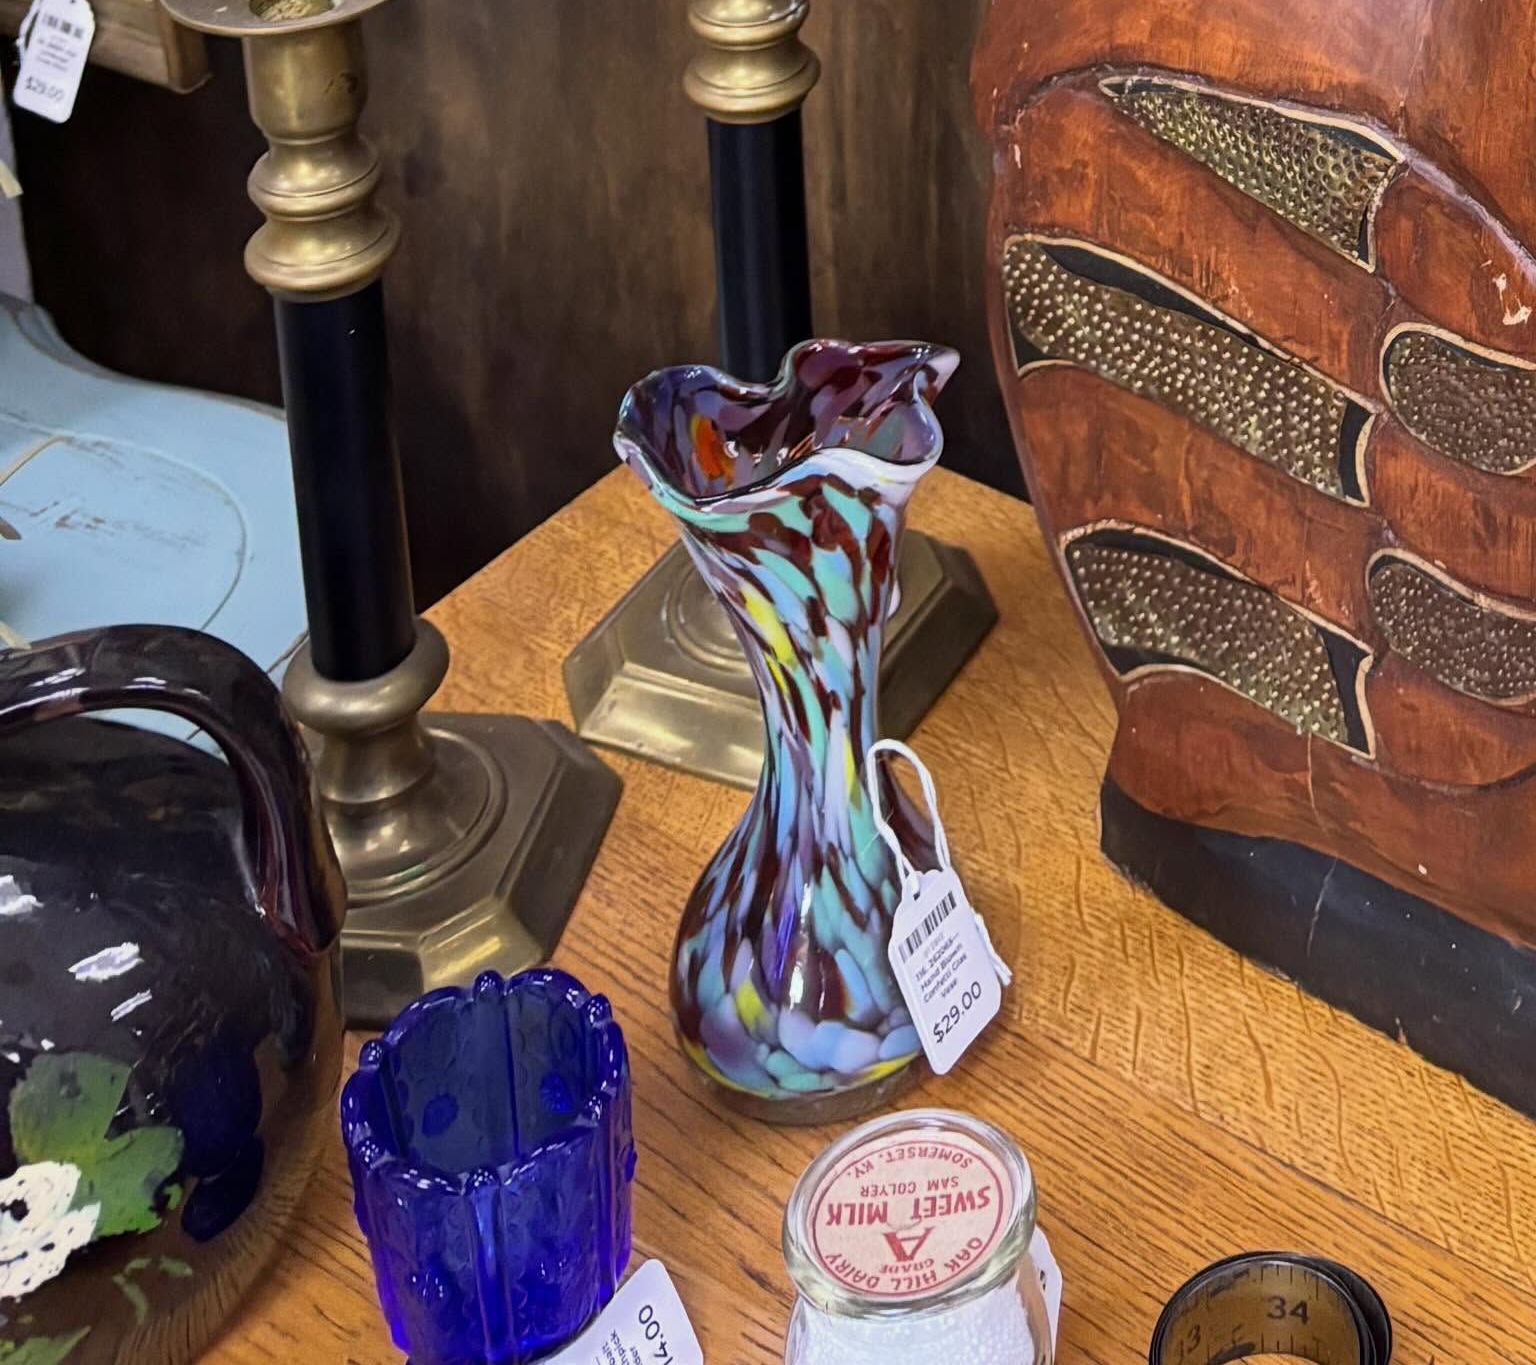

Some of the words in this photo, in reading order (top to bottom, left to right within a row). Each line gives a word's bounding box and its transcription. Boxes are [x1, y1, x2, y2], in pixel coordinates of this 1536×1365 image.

[933, 981, 982, 1044] $29.00
[859, 1182, 917, 1198] COLYER
[926, 1175, 960, 1191] SAM
[826, 1201, 889, 1227] MILK
[910, 1185, 992, 1221] SWEET
[881, 1226, 937, 1262] A
[944, 1236, 983, 1272] OAK
[824, 1251, 881, 1289] DAIRY
[878, 1257, 935, 1275] GRADE
[889, 1268, 938, 1293] HILL
[1265, 1295, 1310, 1326] 34
